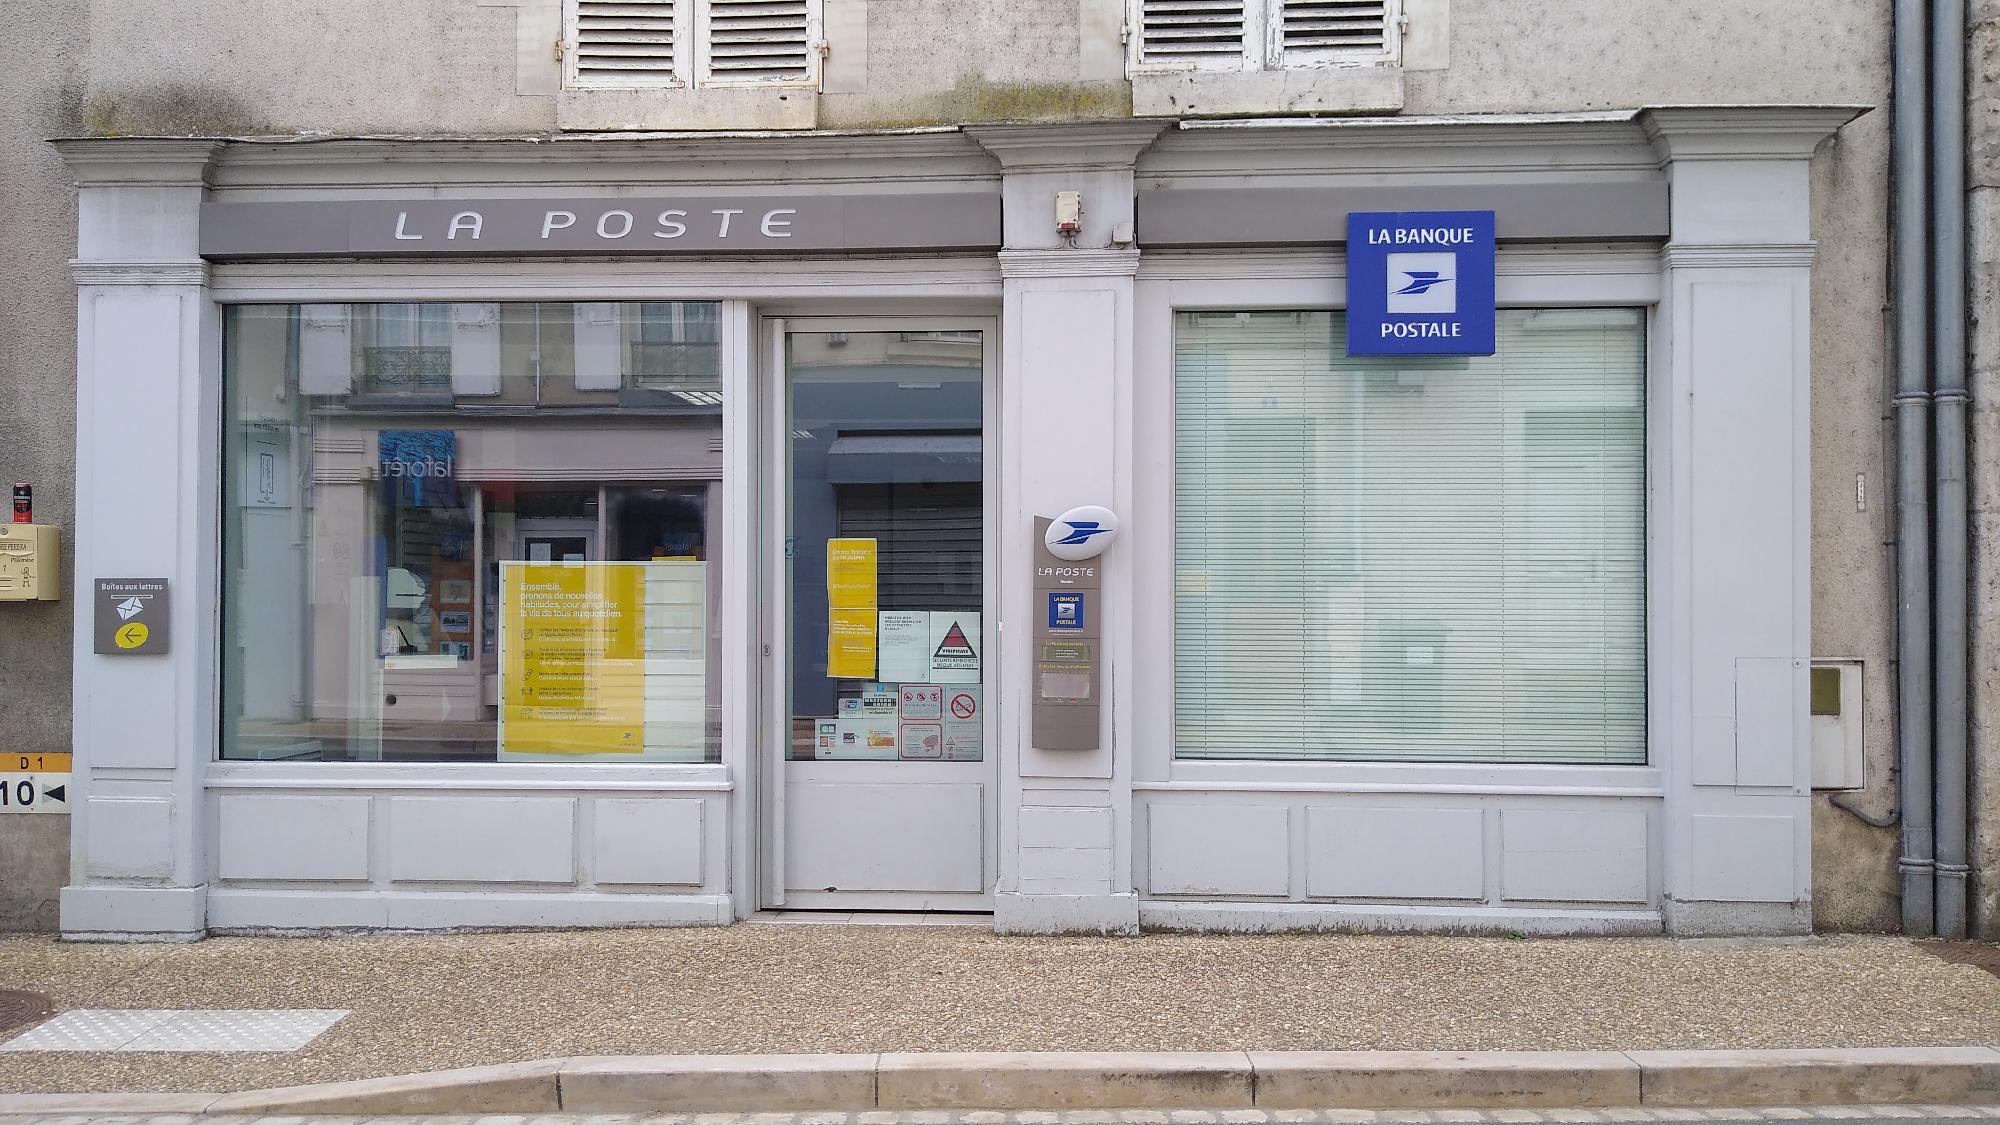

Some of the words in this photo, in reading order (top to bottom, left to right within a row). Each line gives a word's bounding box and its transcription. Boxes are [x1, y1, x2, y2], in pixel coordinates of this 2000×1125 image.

[394, 211, 484, 240] LA
[540, 208, 797, 239] POSTE
[1368, 228, 1391, 244] LA
[1395, 227, 1474, 246] BANQUE
[1381, 322, 1462, 338] POSTALE
[1038, 567, 1053, 576] LA
[1055, 567, 1095, 577] POSTE
[139, 582, 163, 590] lettres
[520, 583, 561, 591] Ensemble,
[520, 593, 553, 601] prenons
[565, 592, 604, 600] nouvelles
[20, 756, 30, 770] D
[37, 756, 44, 770] 1
